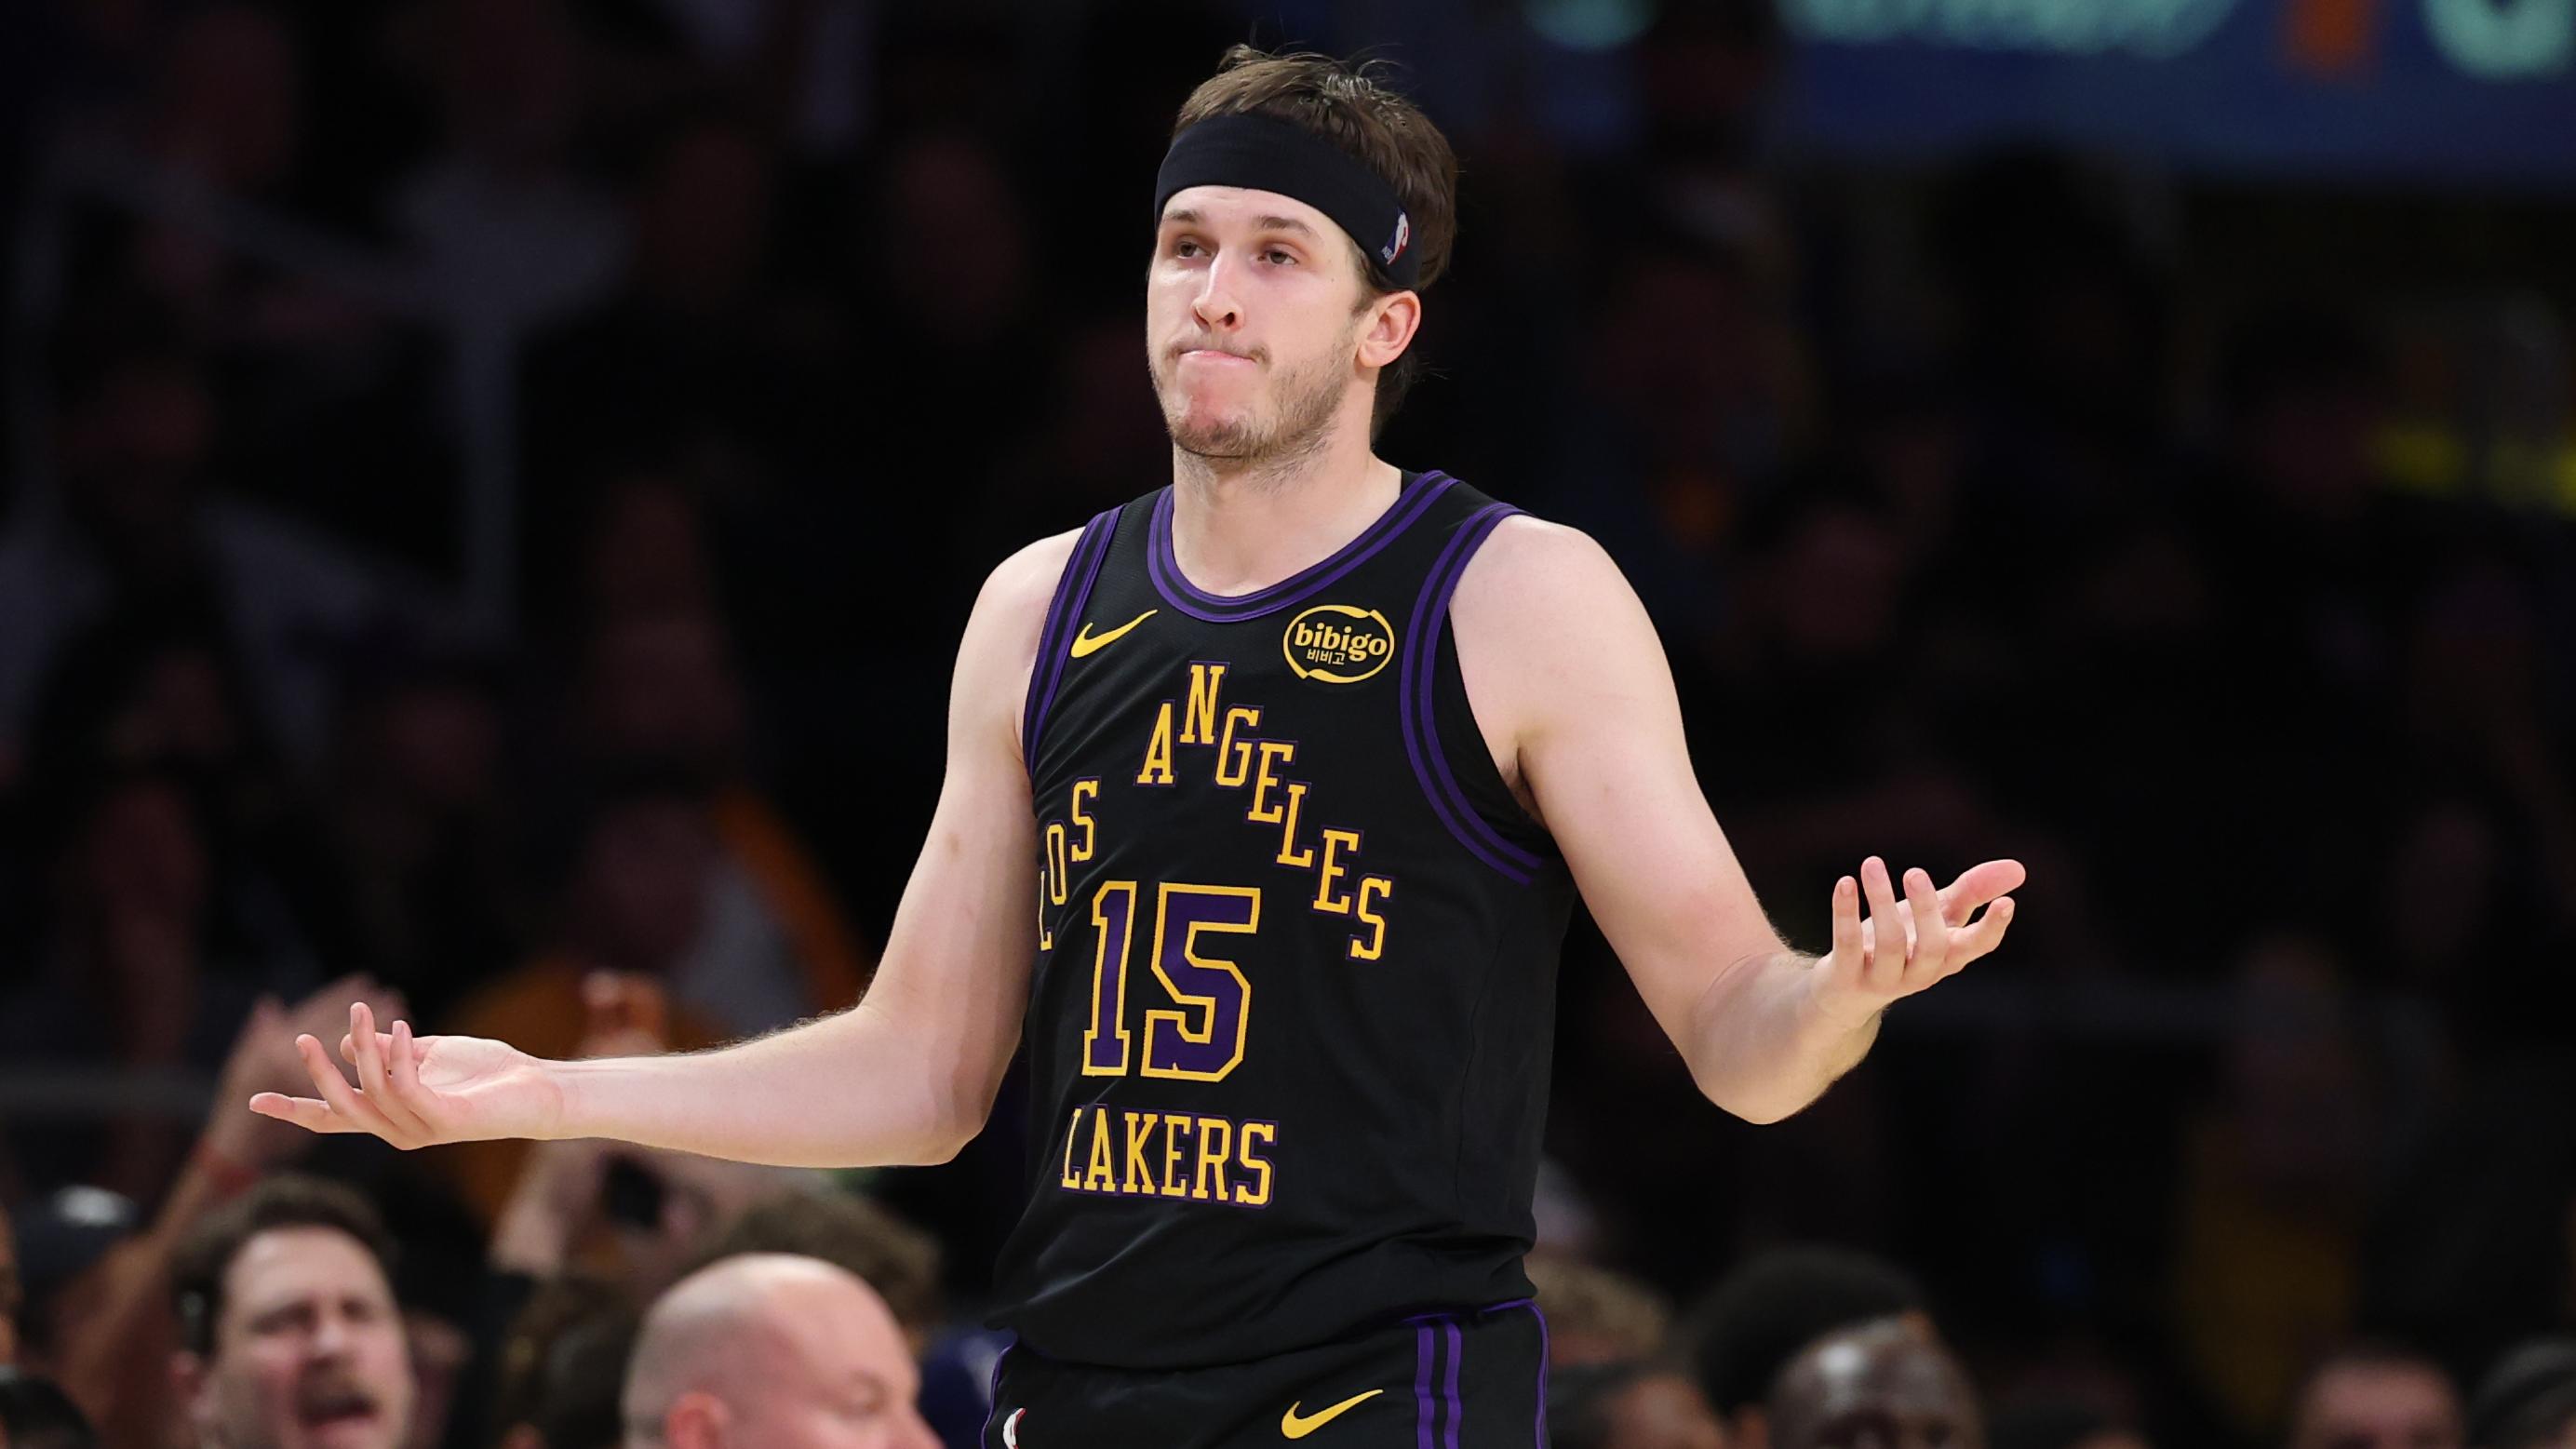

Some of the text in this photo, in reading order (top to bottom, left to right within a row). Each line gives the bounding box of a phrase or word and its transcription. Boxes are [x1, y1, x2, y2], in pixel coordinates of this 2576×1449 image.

[1295, 622, 1389, 663] bibigo
[1307, 649, 1347, 666] 비비고
[1038, 661, 1392, 961] LOS ANGELES
[1080, 880, 1262, 1083] 15
[1061, 1104, 1279, 1208] LAKERS
